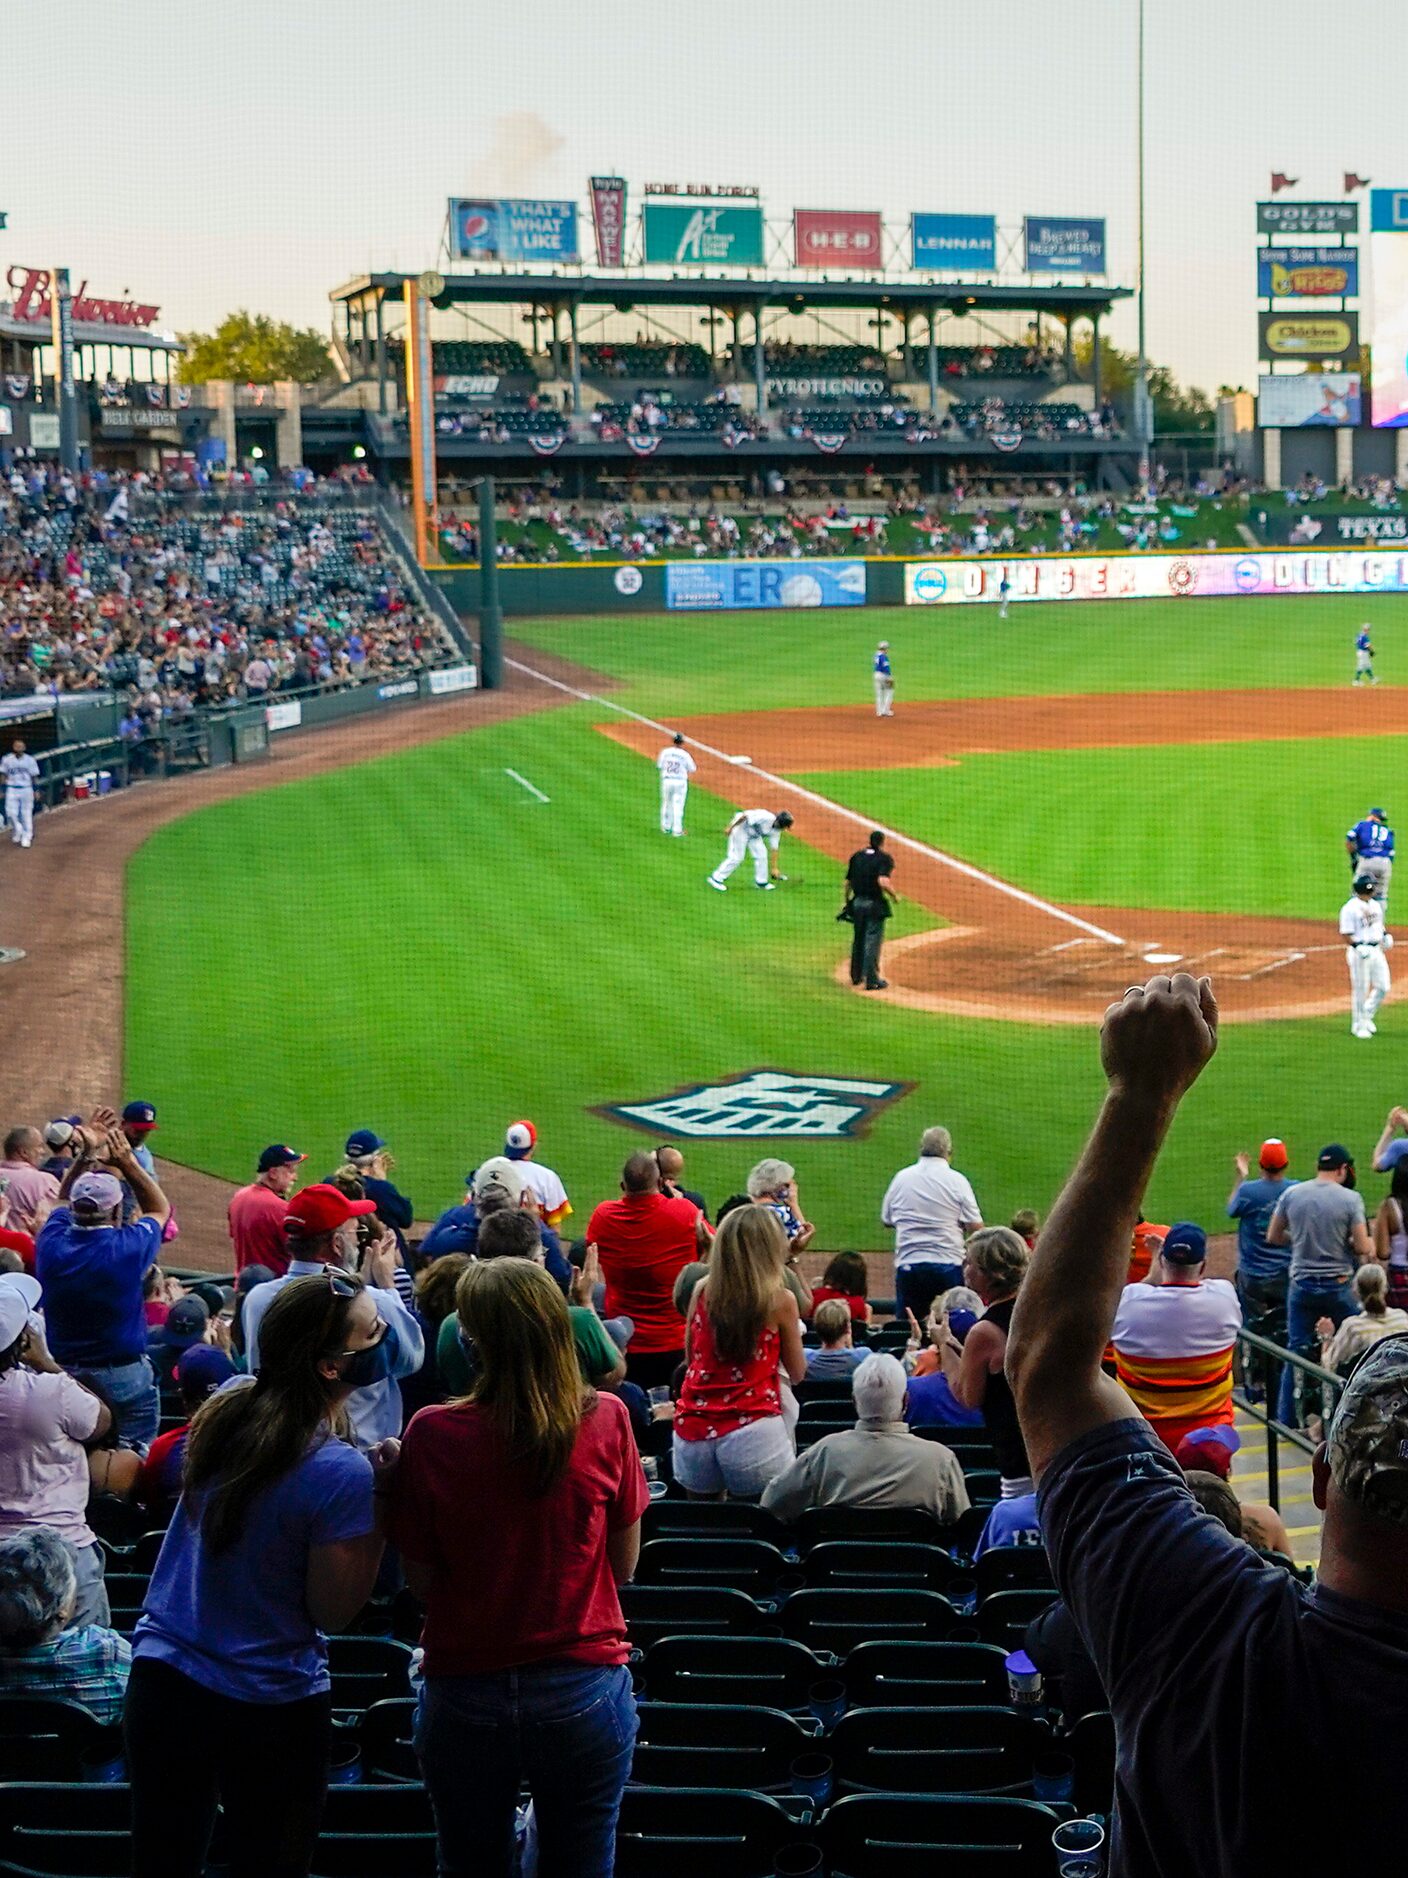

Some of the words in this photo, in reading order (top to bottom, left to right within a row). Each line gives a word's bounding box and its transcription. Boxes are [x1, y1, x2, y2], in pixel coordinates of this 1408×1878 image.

[511, 202, 571, 218] THAT'S
[511, 217, 563, 233] WHAT
[522, 234, 563, 249] LIKE
[917, 236, 993, 250] LENNAR
[445, 375, 499, 393] ECHO
